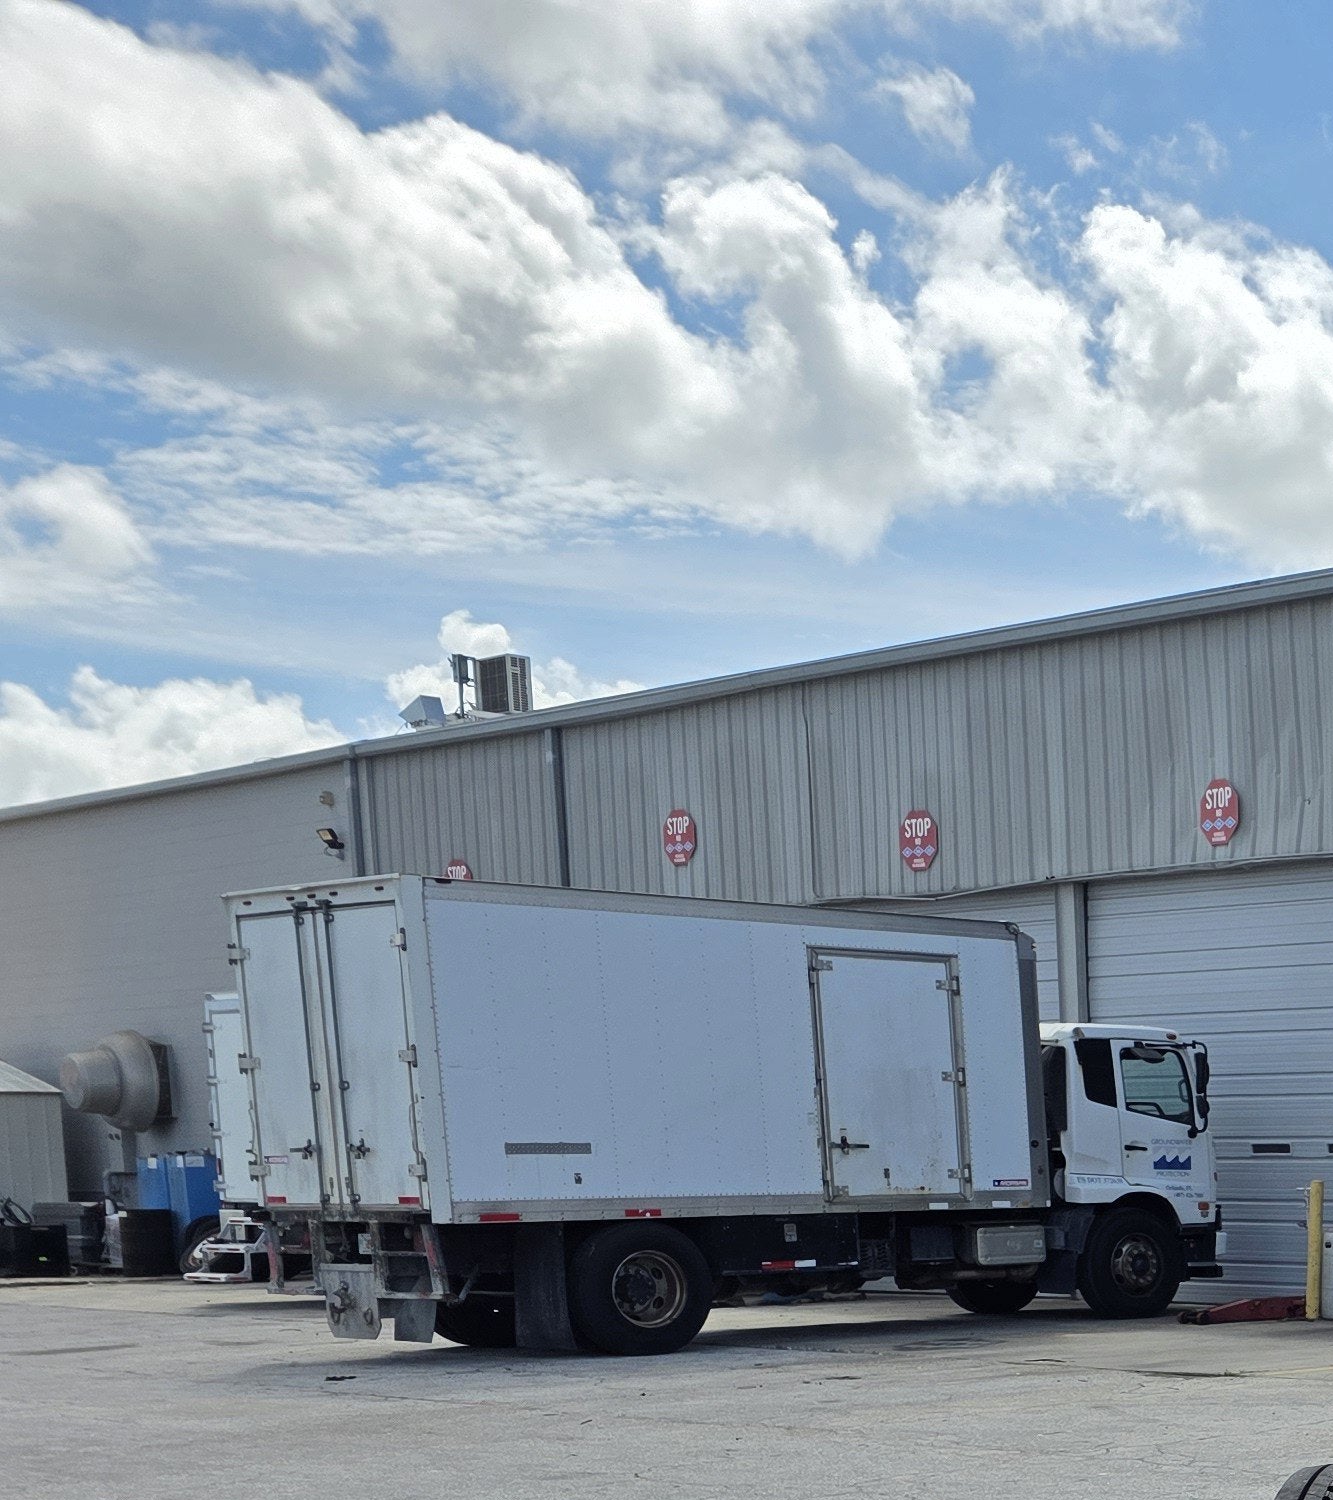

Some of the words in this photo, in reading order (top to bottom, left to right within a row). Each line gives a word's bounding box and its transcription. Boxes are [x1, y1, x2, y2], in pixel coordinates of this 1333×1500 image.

[1205, 786, 1232, 810] STOP
[667, 815, 690, 836] STOP
[904, 817, 931, 838] STOP
[447, 865, 467, 880] STOP
